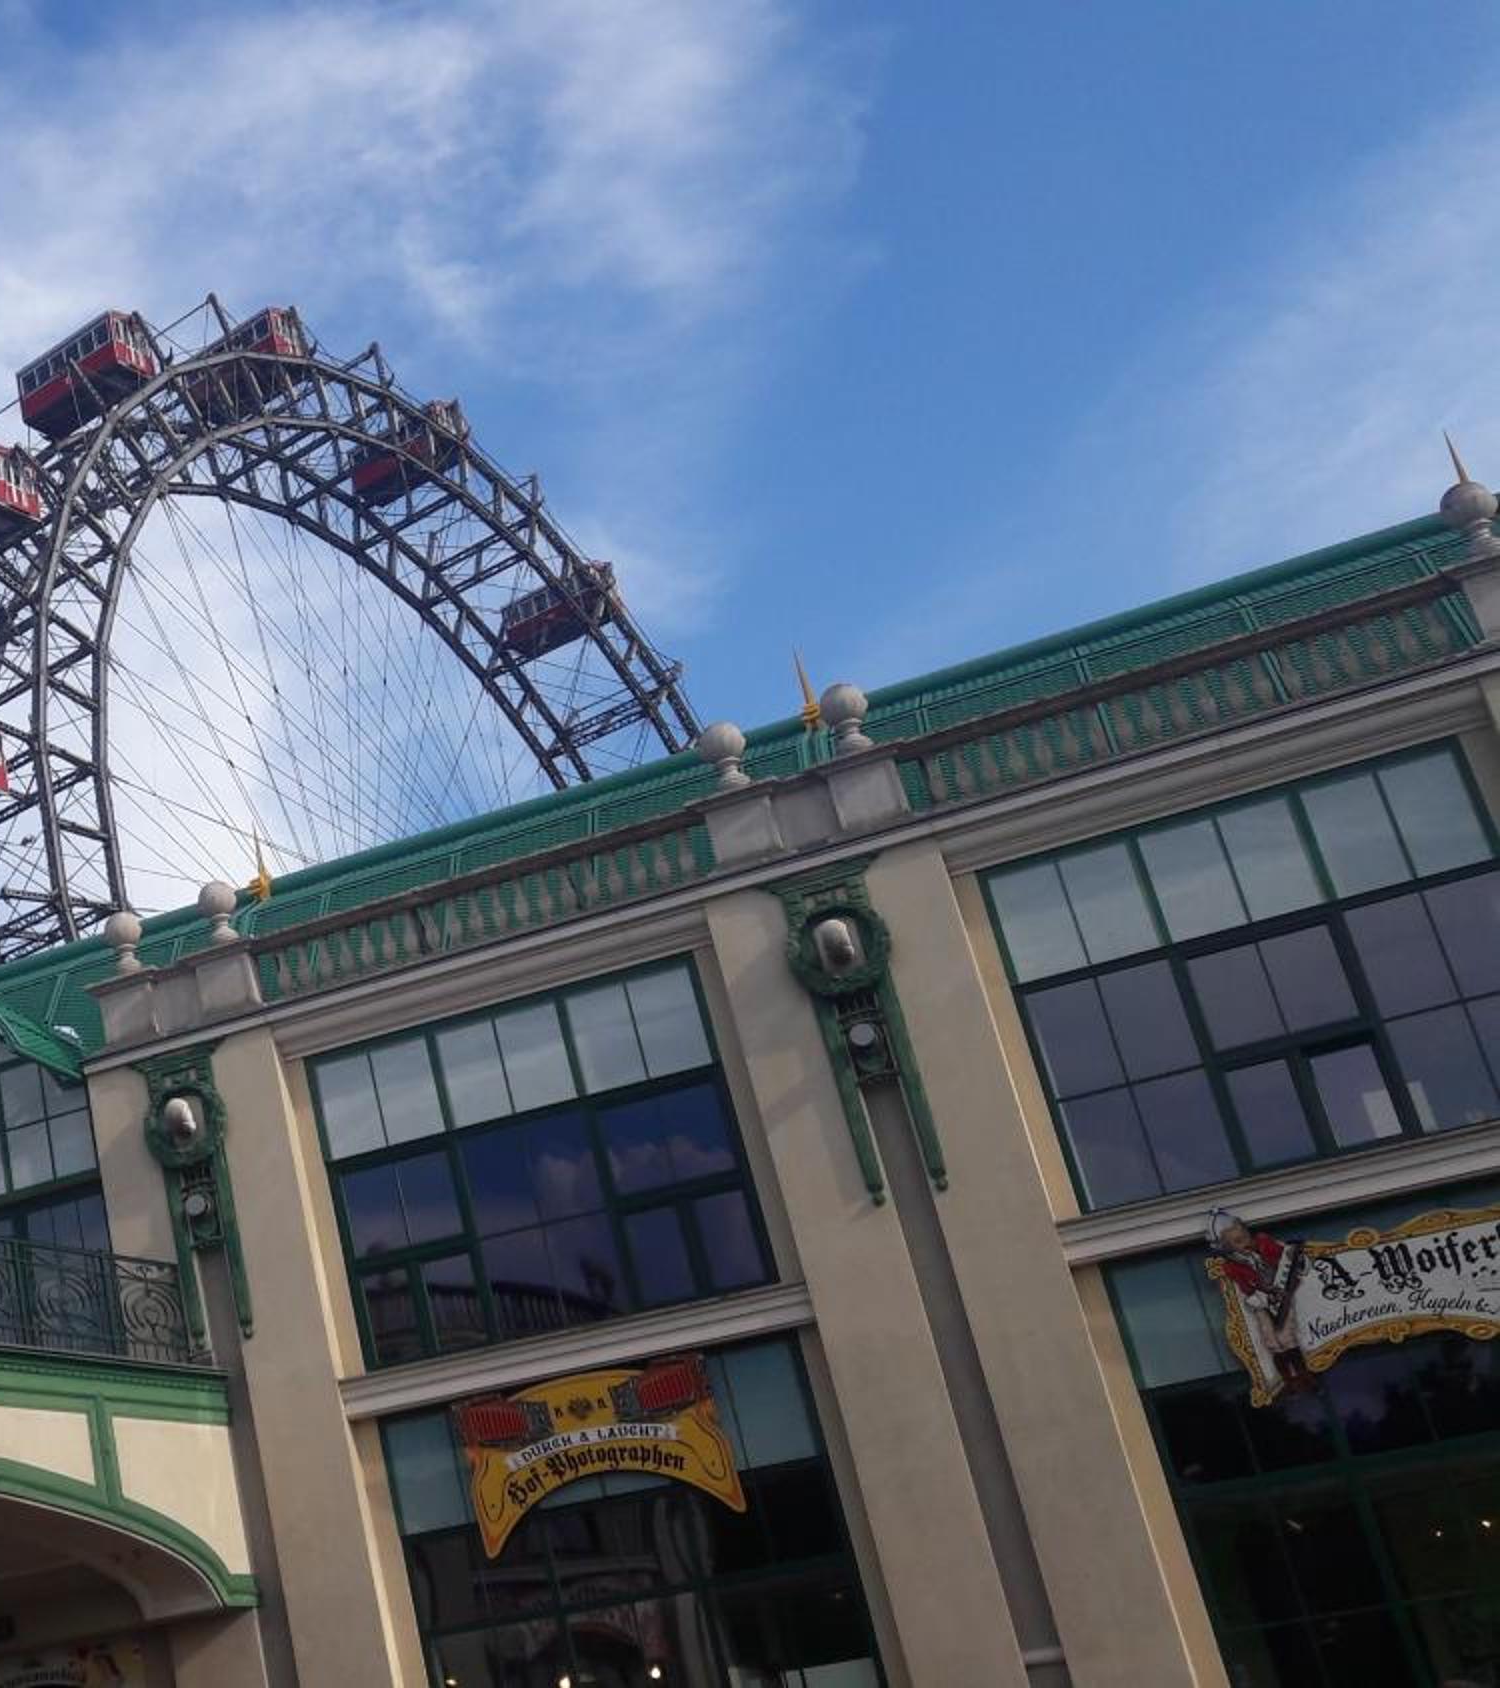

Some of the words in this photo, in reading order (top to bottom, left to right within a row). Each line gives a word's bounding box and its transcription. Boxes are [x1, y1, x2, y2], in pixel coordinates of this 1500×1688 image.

[1408, 1288, 1472, 1316] Kugeln
[521, 1436, 573, 1463] DURCH
[579, 1432, 590, 1443] &
[507, 1444, 687, 1505] Hof-Photographen
